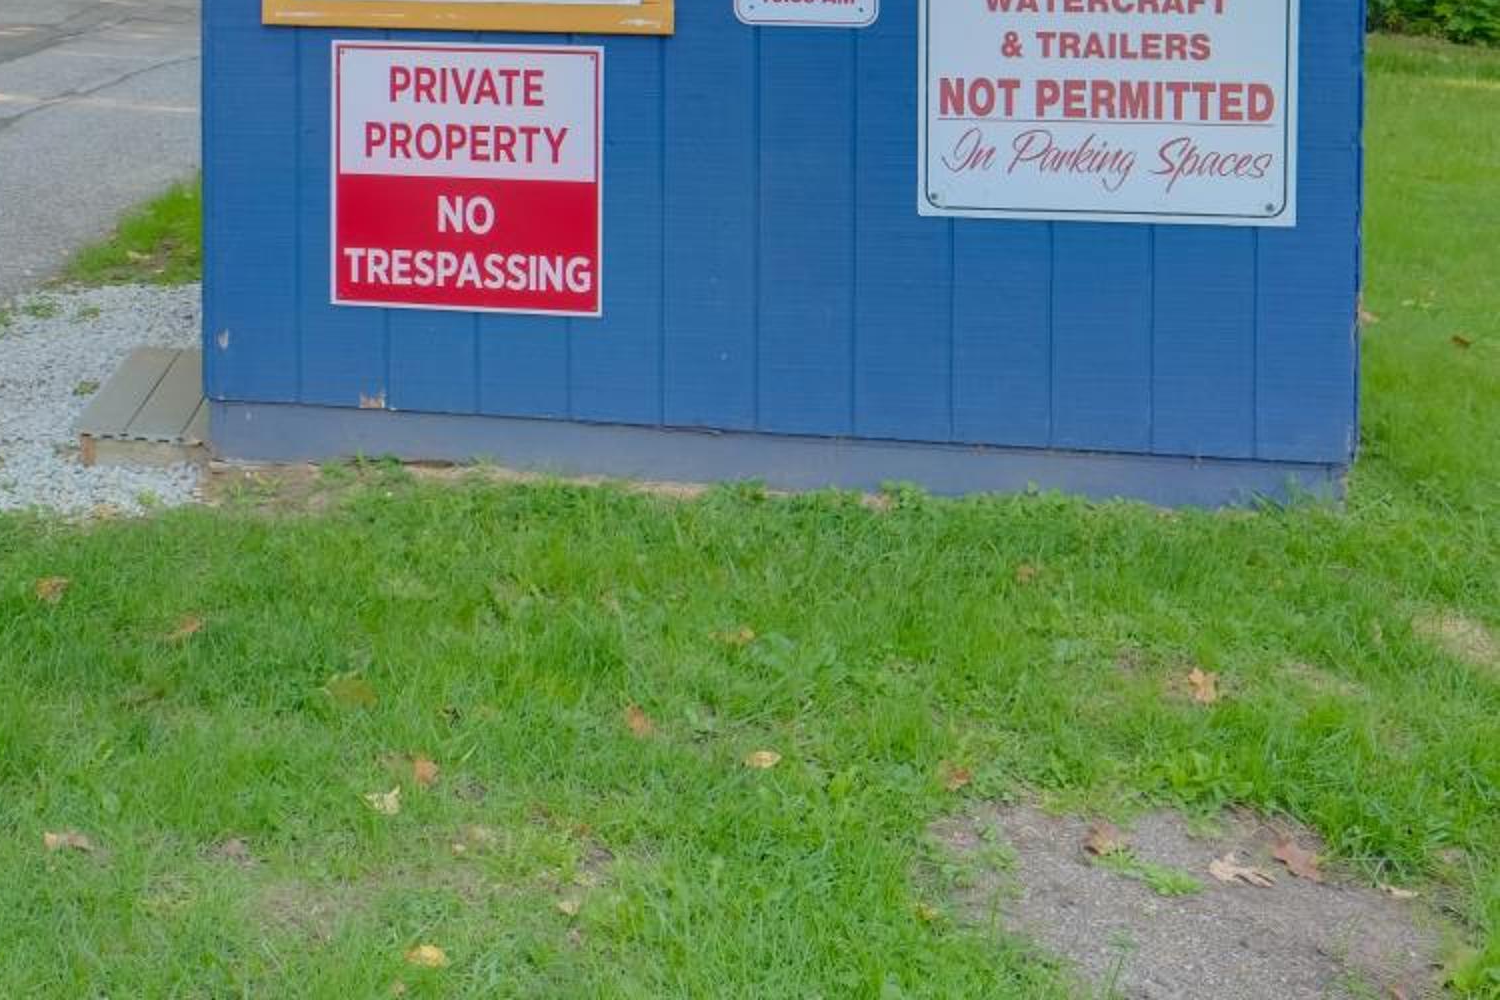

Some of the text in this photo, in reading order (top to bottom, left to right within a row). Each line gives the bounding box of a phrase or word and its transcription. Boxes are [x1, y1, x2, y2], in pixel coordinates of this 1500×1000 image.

[1001, 31, 1211, 61] & TRAILERS
[390, 65, 545, 107] PRIVATE
[939, 77, 1275, 122] NOT PERMITTED
[364, 121, 568, 164] PROPERTY
[941, 127, 1273, 194] In Parking Spaces
[436, 194, 496, 235] NO
[344, 247, 592, 293] TRESPASSING
